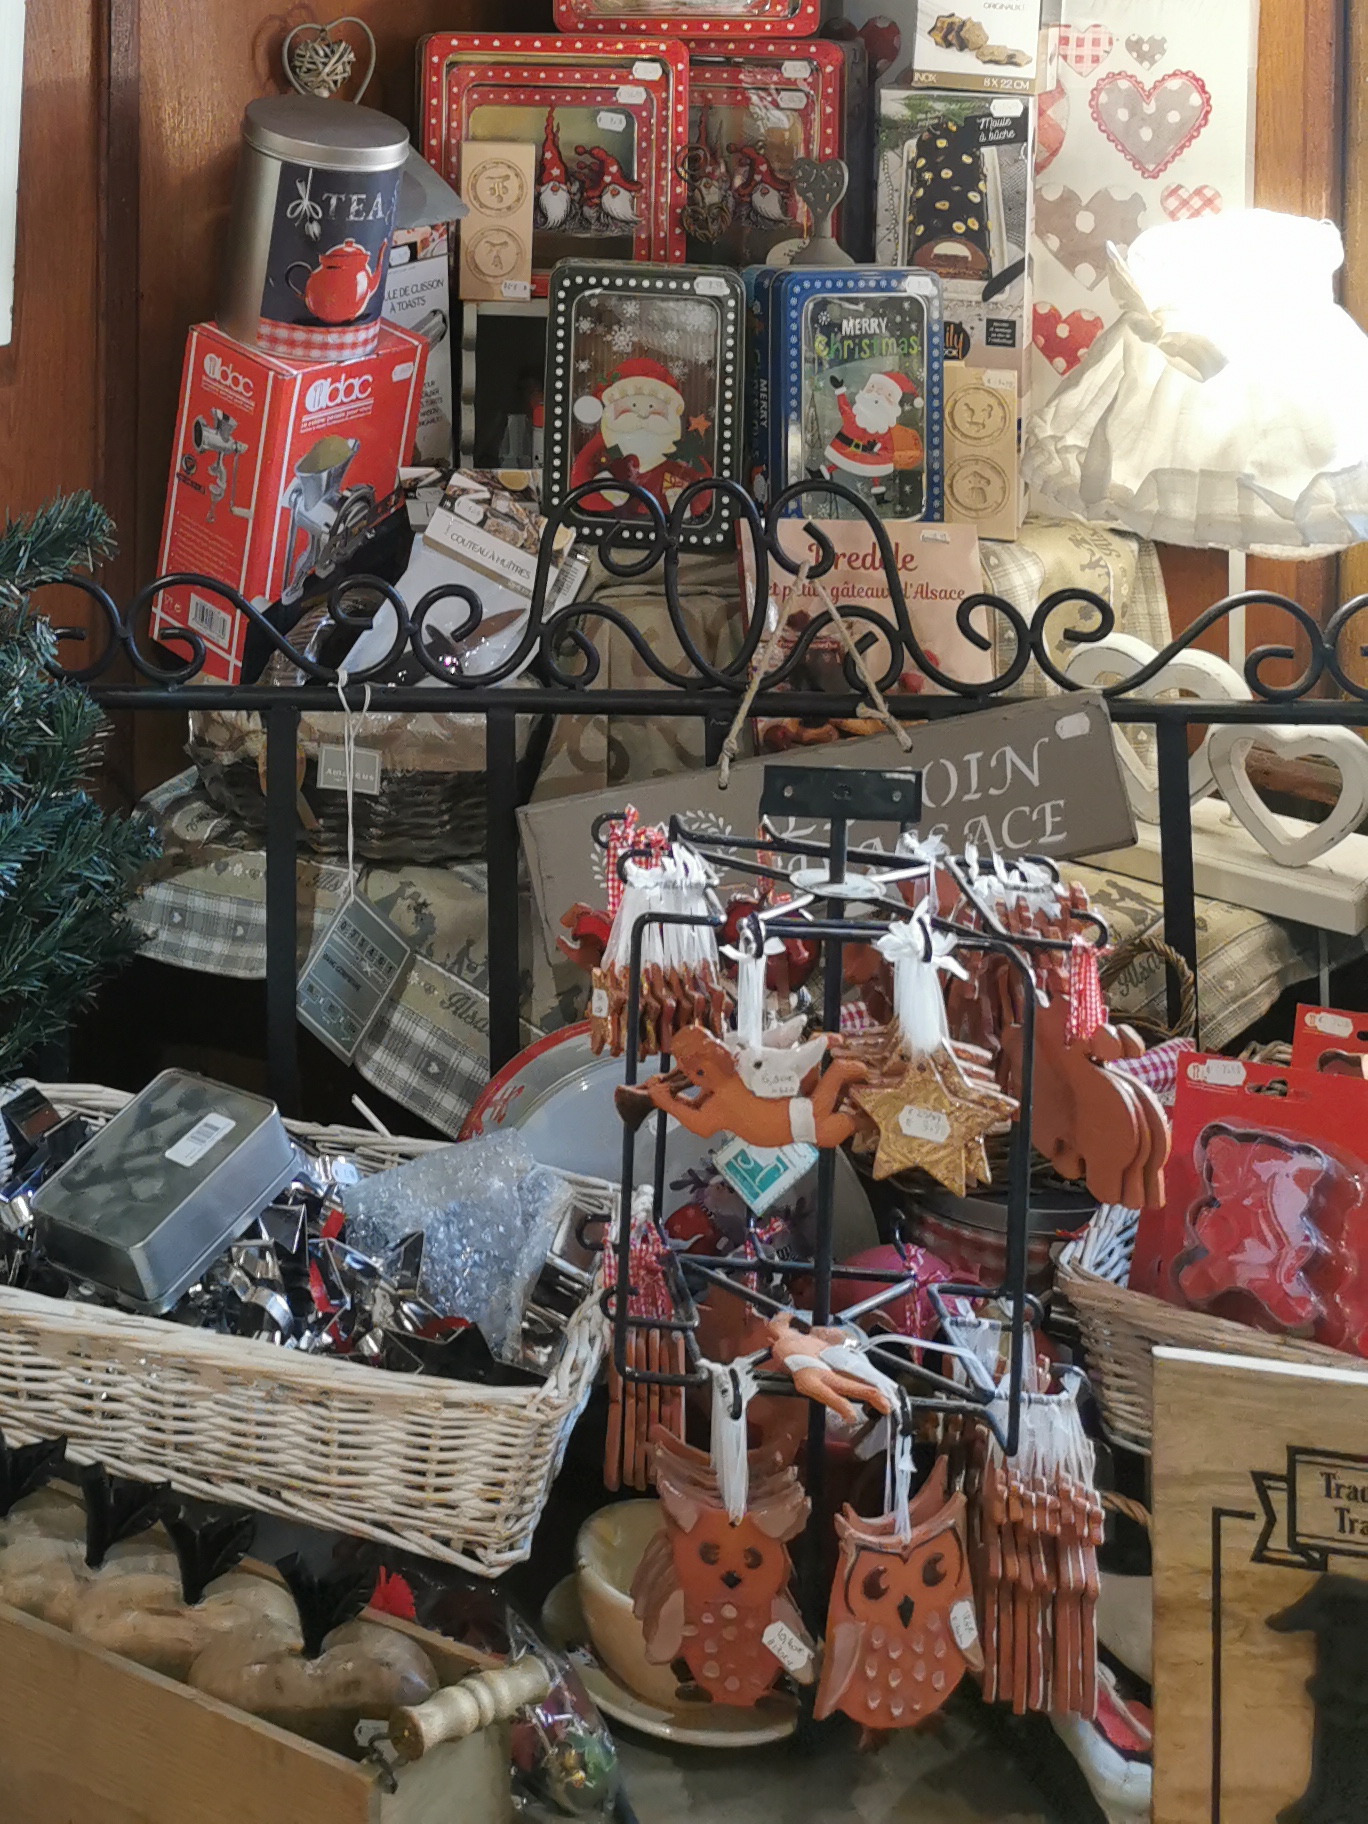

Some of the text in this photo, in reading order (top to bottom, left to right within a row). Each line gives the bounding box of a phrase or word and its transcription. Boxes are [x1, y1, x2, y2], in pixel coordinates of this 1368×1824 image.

[914, 72, 937, 83] INOX
[1000, 79, 1013, 88] 22
[1013, 80, 1030, 90] CM
[977, 117, 1011, 130] Moule
[322, 192, 385, 222] TEA
[401, 285, 411, 297] DE
[411, 279, 444, 295] CUISSON
[397, 295, 426, 311] TOASTS
[842, 317, 887, 336] MERRY
[451, 533, 489, 557] COUTEAU
[495, 558, 531, 580] HUÎTRES
[808, 541, 918, 572] redle
[830, 581, 890, 605] gâteau
[921, 737, 1050, 808] OIN
